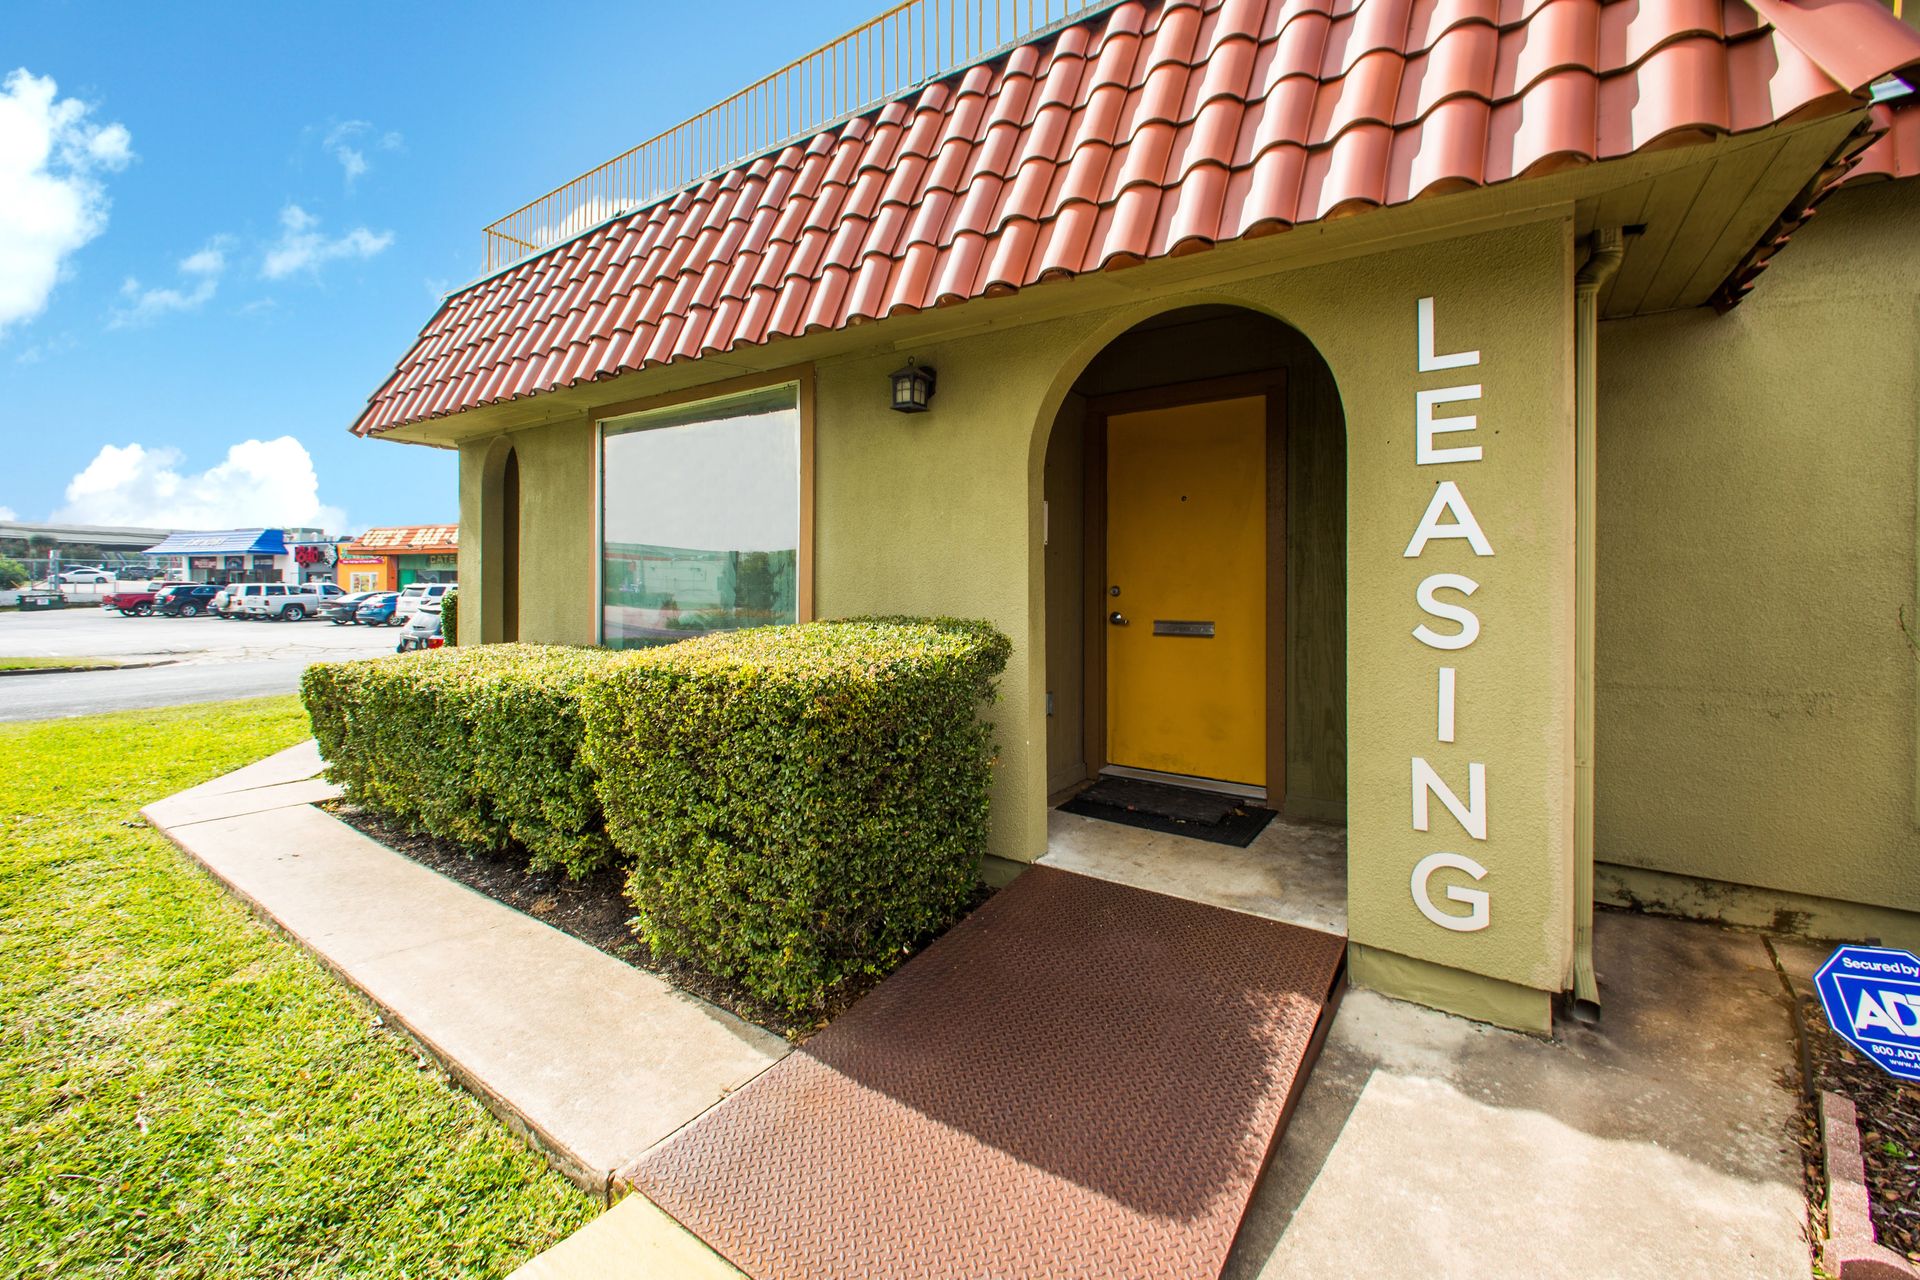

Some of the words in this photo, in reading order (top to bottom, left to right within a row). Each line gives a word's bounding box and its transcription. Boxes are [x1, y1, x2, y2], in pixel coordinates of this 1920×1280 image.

[1403, 296, 1496, 934] LEASING
[1842, 957, 1901, 974] Secured
[1901, 963, 1920, 977] by
[1854, 988, 1920, 1037] AD
